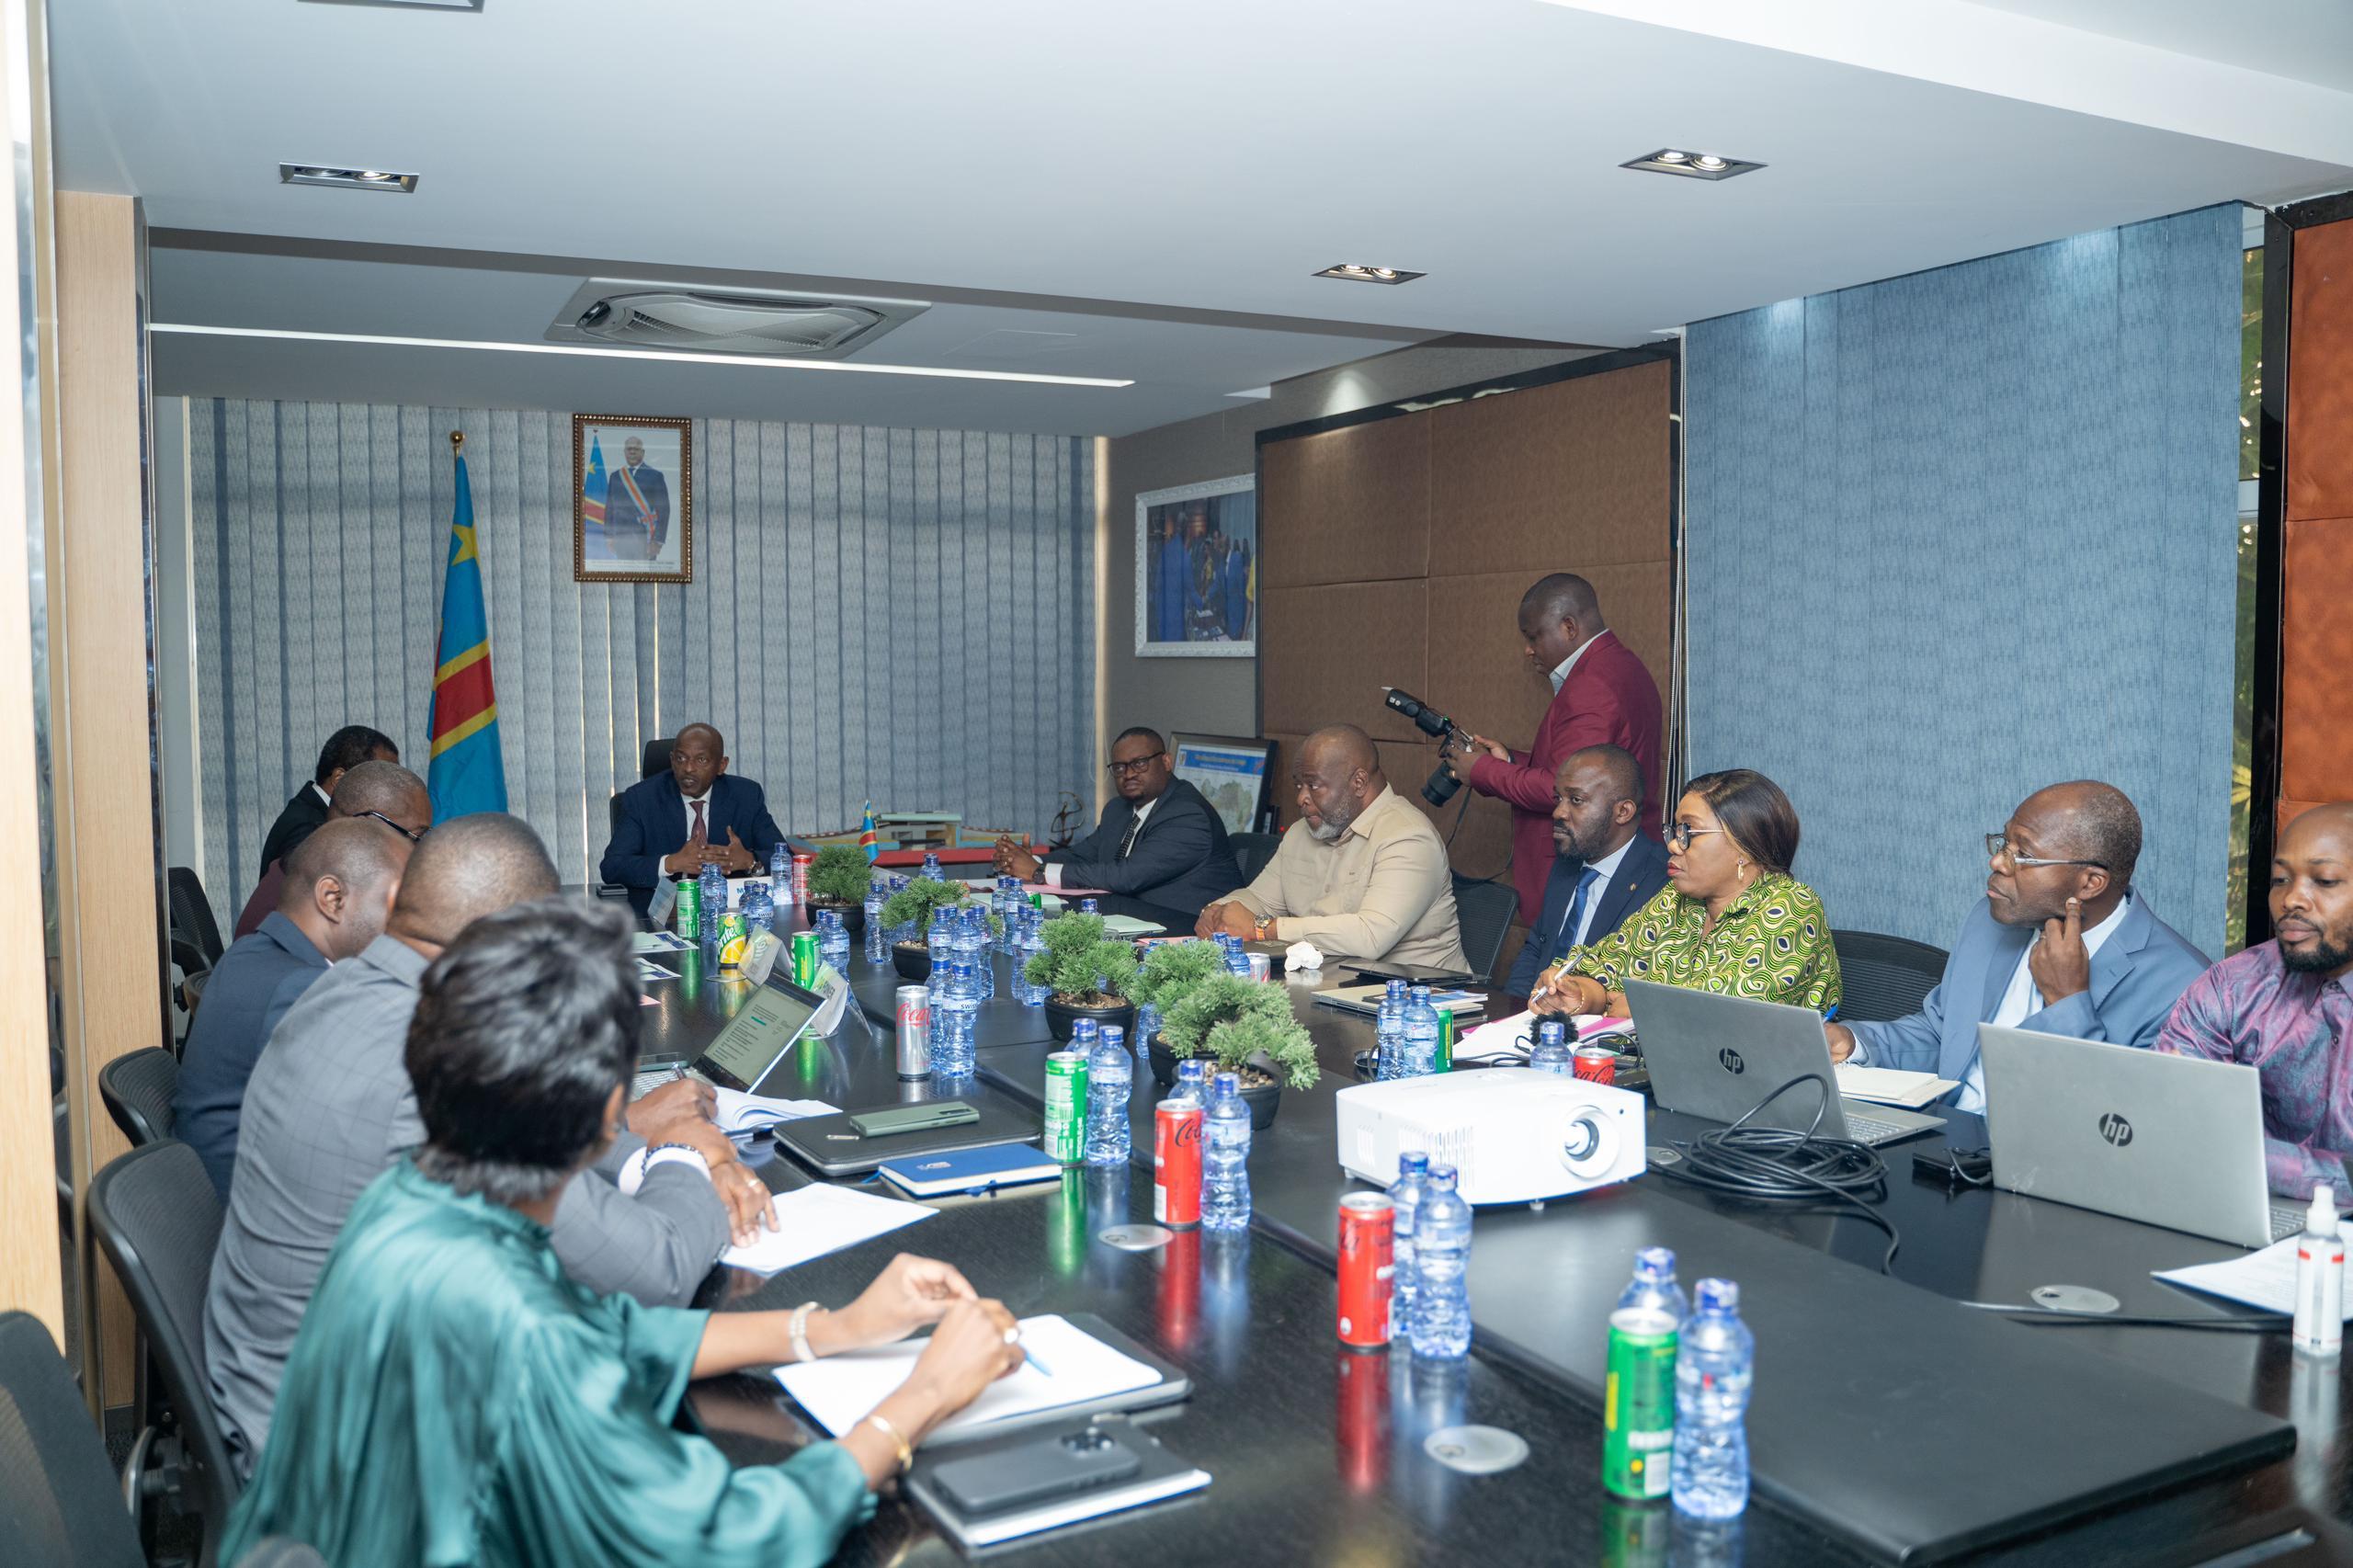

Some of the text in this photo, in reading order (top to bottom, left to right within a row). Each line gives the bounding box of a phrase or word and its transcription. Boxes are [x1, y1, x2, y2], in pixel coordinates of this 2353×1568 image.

[718, 926, 737, 954] prite
[1720, 1048, 1744, 1074] hp
[2099, 1113, 2132, 1146] hp
